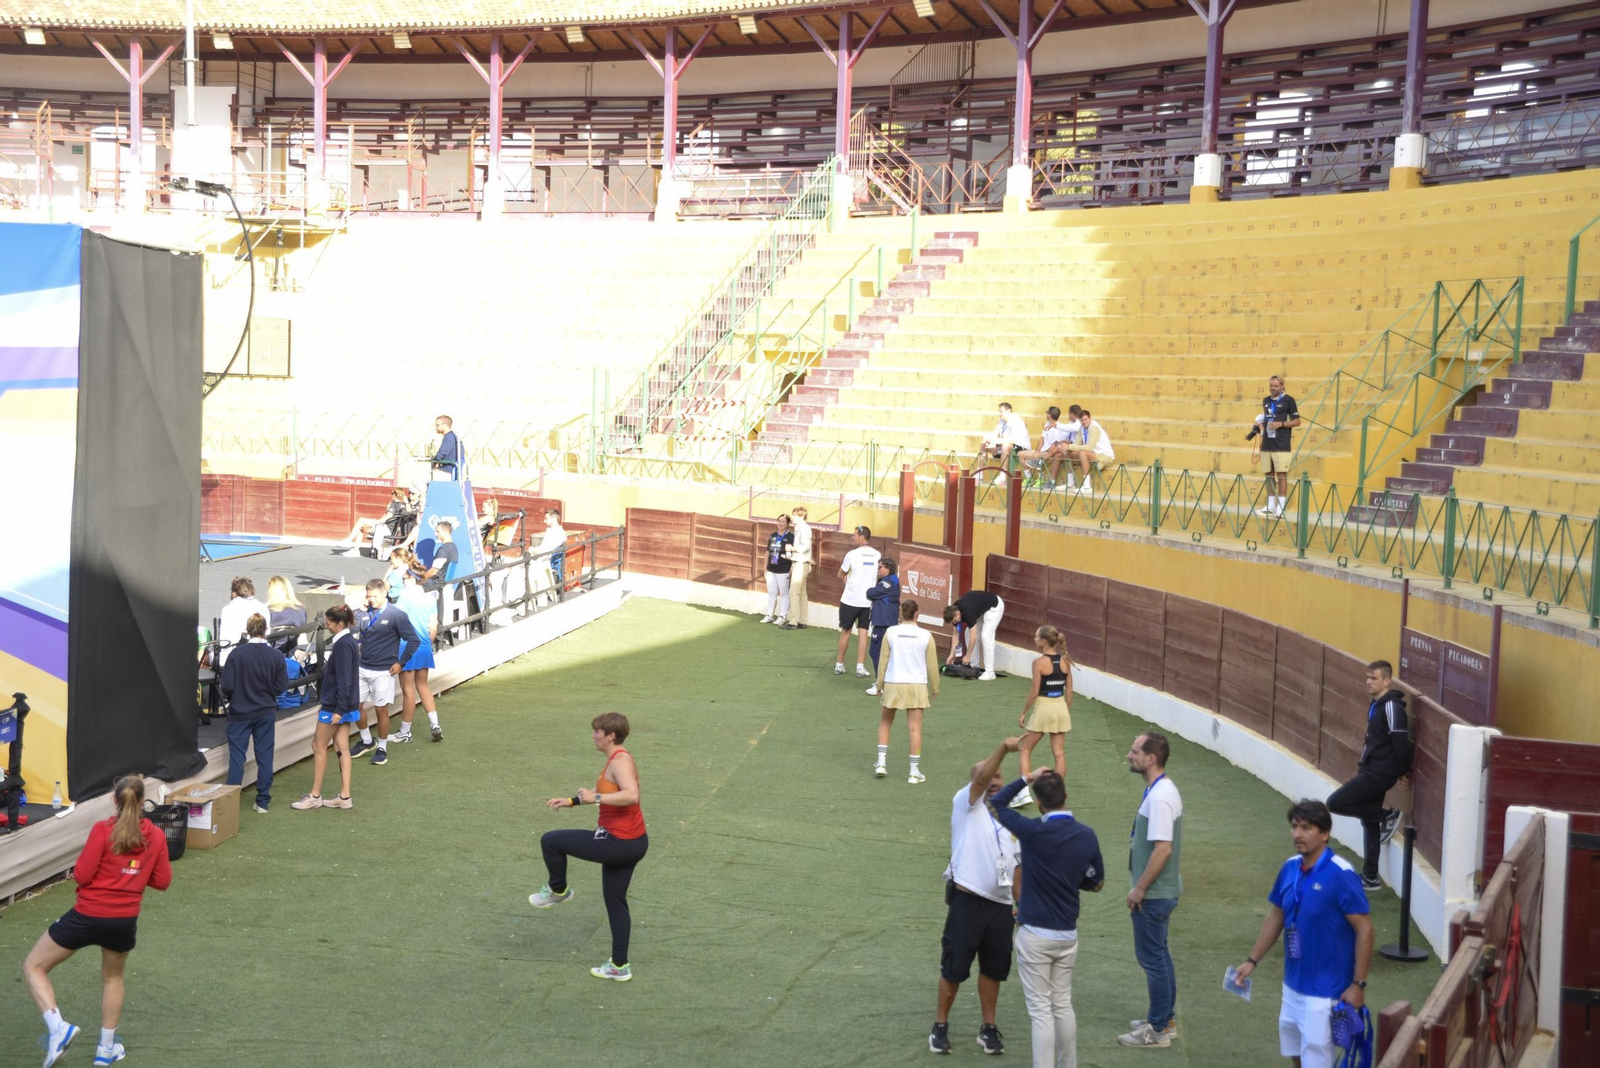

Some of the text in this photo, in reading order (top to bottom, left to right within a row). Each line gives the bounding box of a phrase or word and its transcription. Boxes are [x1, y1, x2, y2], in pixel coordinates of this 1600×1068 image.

[1511, 383, 1517, 393] F
[1503, 393, 1510, 404] 2
[1449, 439, 1454, 448] F
[1441, 450, 1444, 461] 1
[920, 572, 946, 587] Diputación
[919, 587, 941, 601] de Cádiz
[1410, 636, 1483, 672] PRENSA PICADORES
